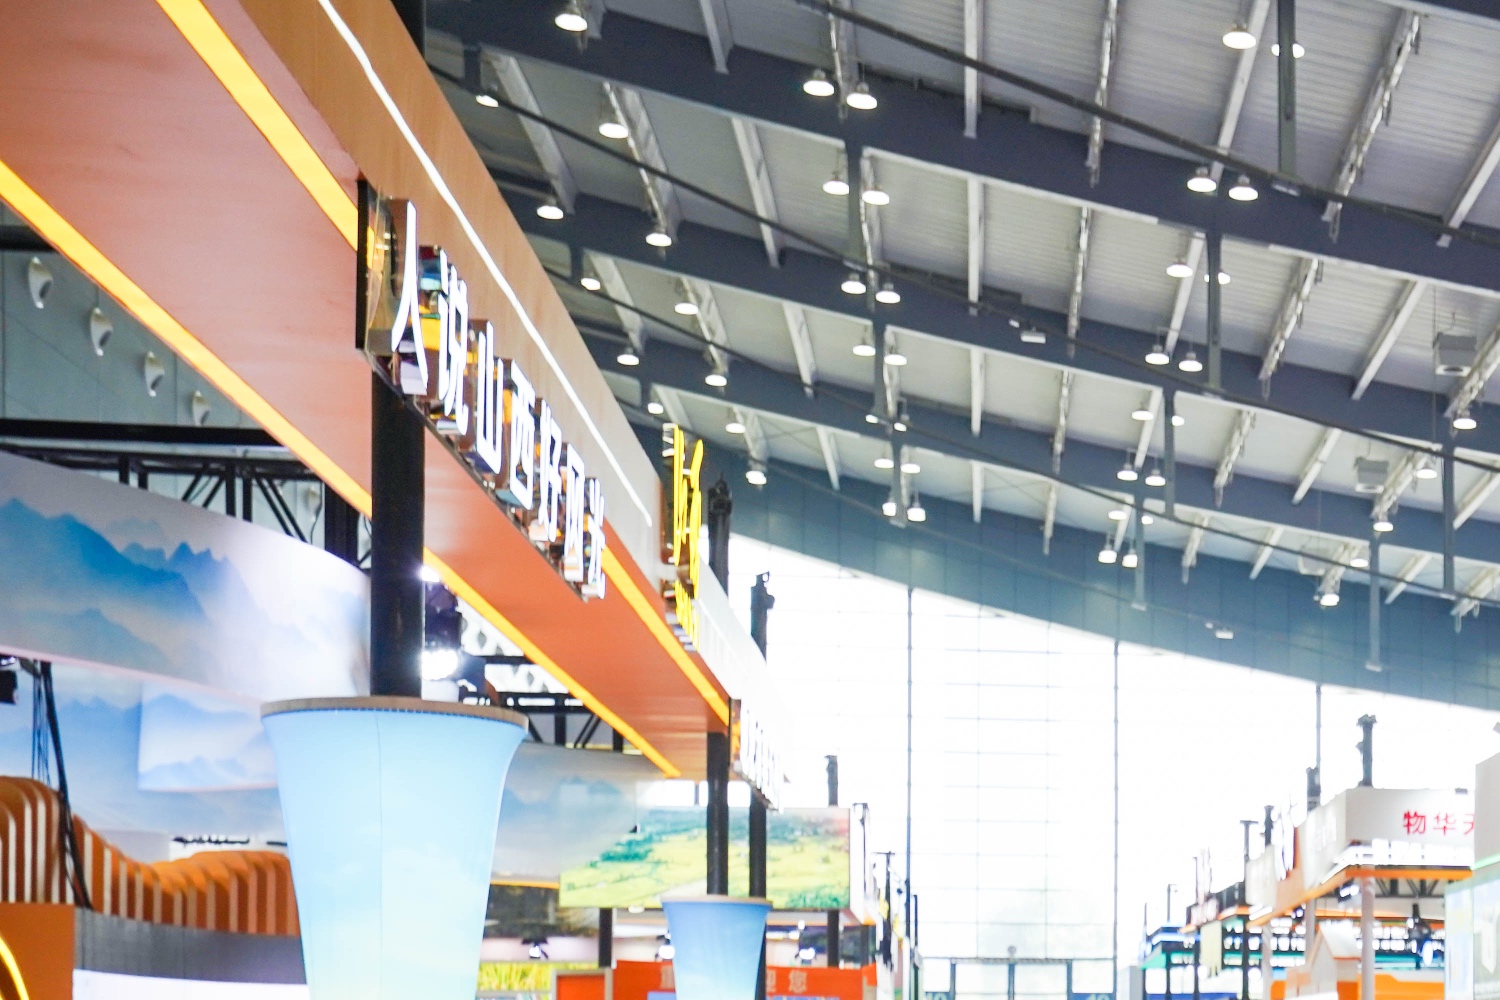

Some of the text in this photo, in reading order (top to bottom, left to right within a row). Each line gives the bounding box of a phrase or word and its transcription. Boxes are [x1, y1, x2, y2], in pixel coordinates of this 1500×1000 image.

[391, 200, 606, 599] 人说山西好风光
